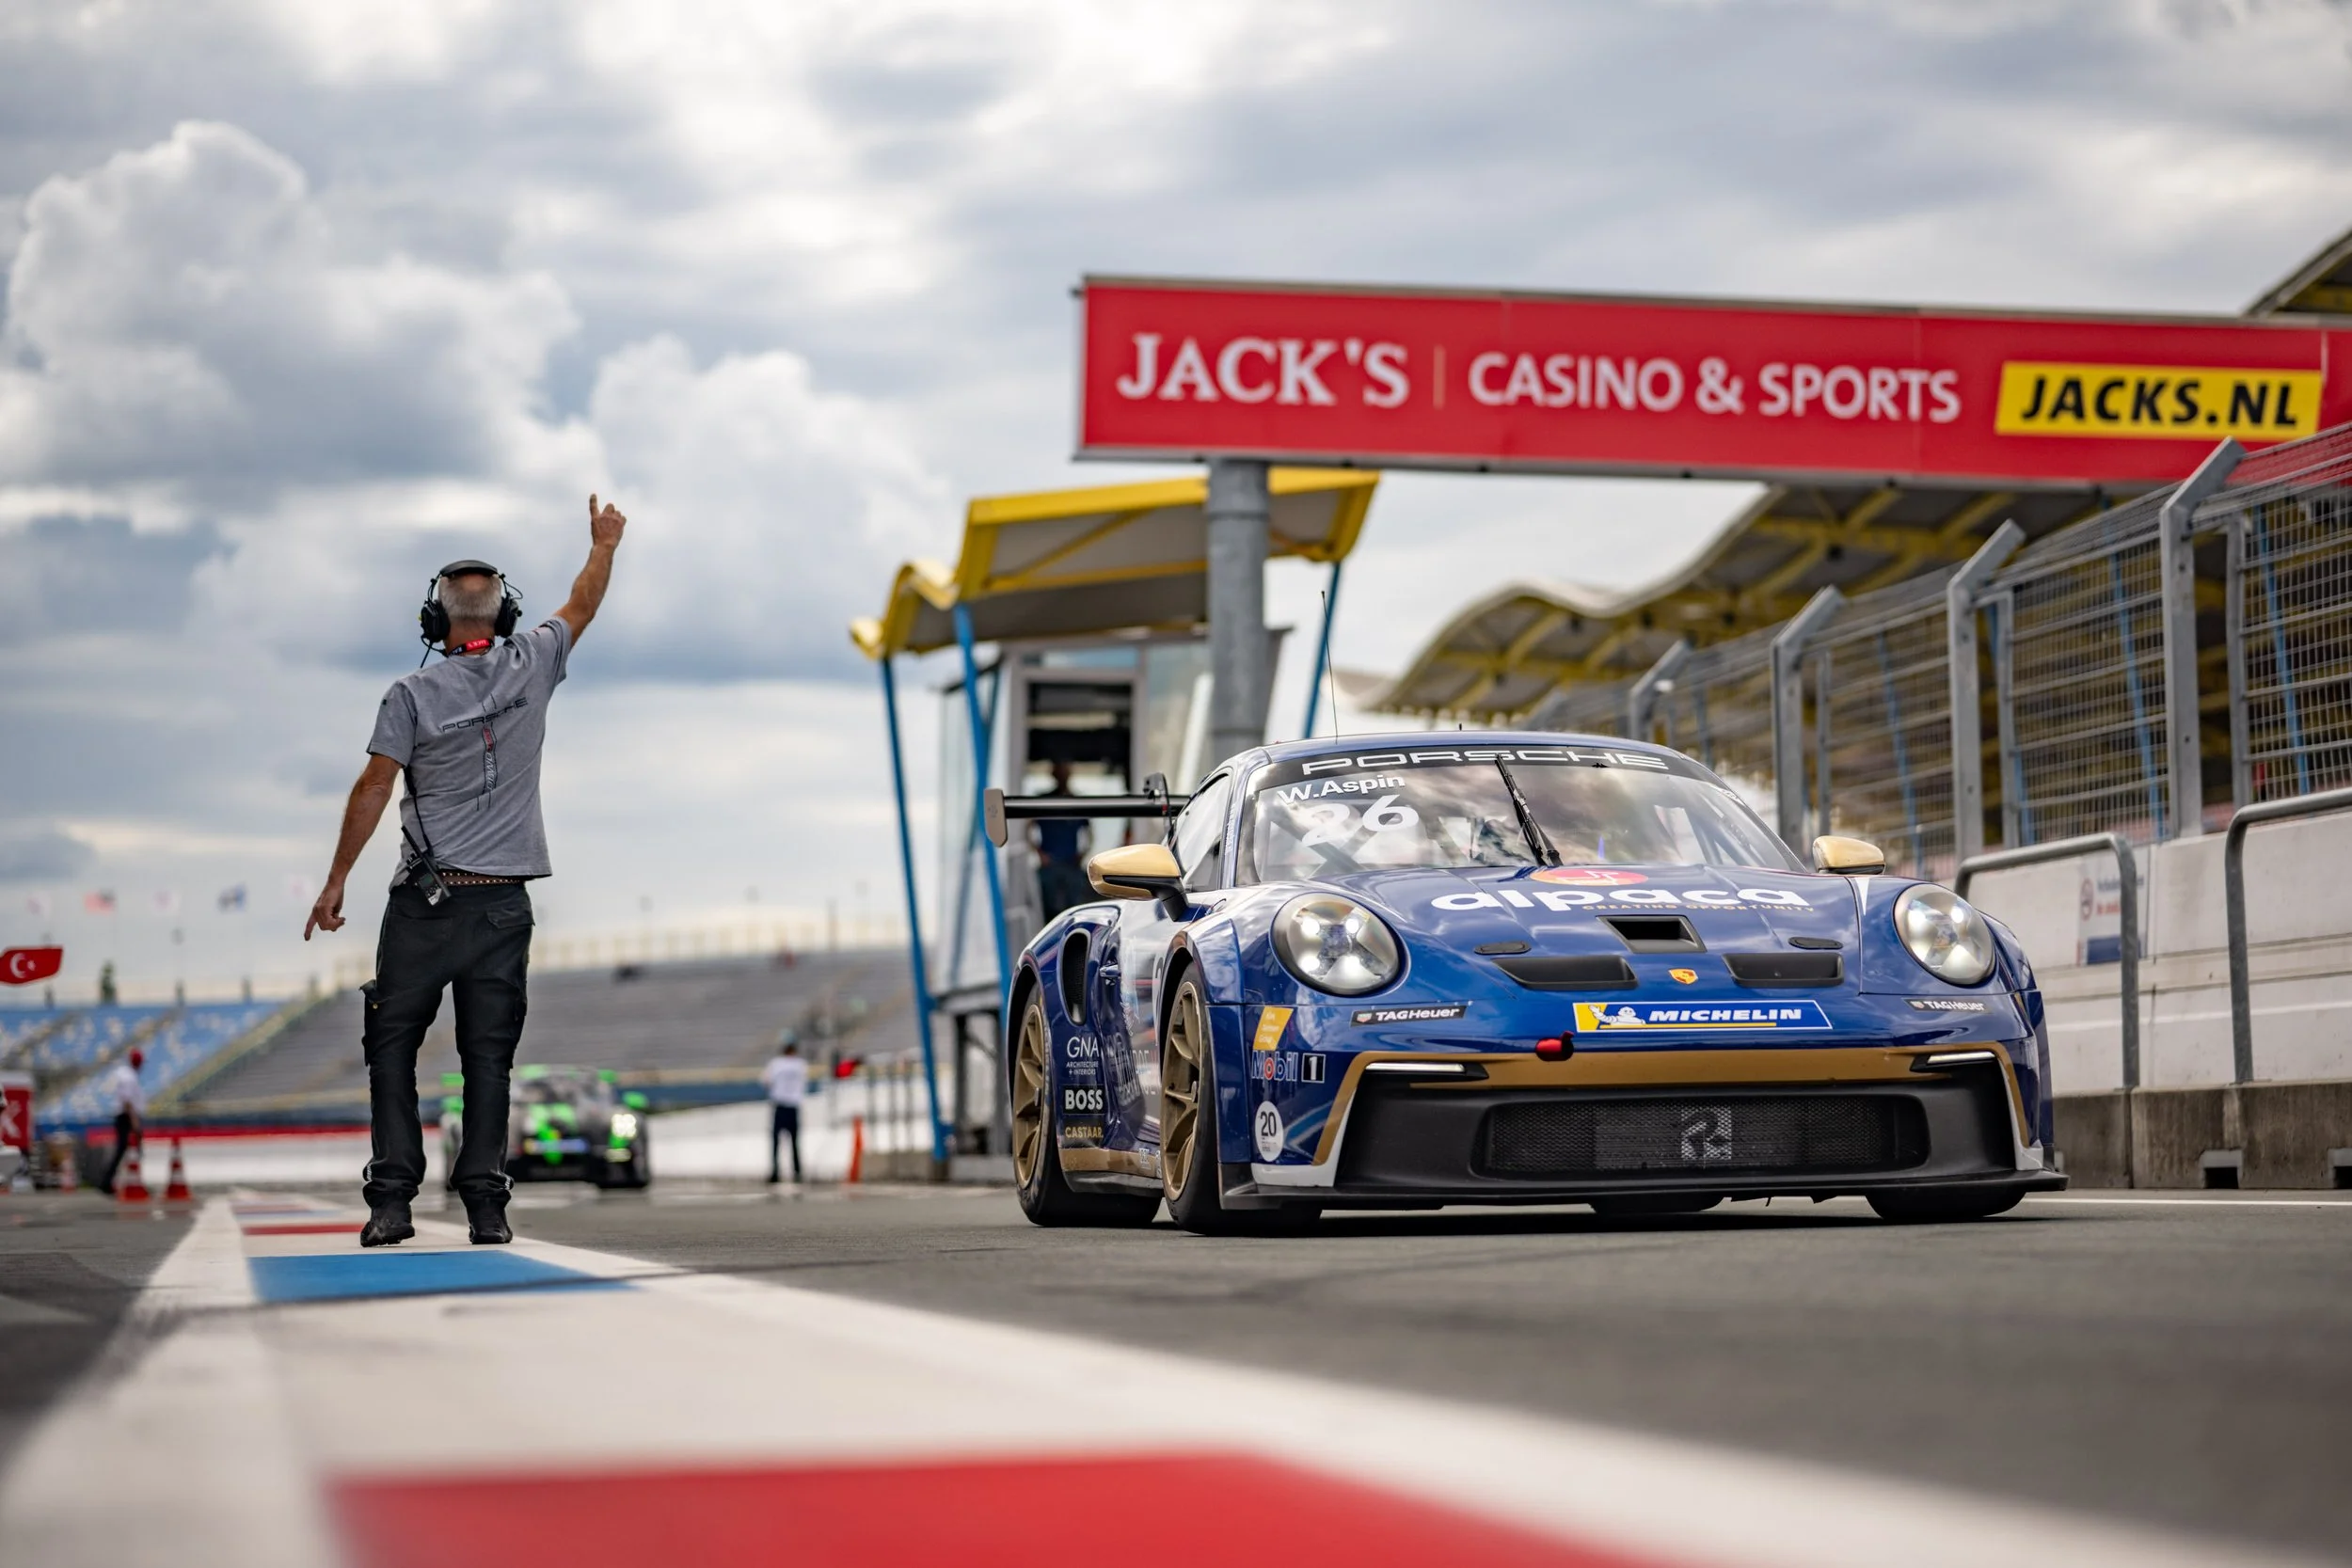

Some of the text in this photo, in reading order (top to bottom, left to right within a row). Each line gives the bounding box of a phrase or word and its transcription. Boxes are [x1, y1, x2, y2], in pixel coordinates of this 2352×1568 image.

[1116, 333, 1961, 424] JACK'S CASINO & SPORTS
[2022, 374, 2298, 426] JACKS.NL
[442, 697, 528, 733] PORSCHE
[1302, 750, 1669, 775] PORSCHE
[1277, 775, 1406, 805] W.Aspin
[1301, 794, 1421, 847] 26
[1431, 887, 1811, 911] alpaca
[1649, 1007, 1803, 1022] MICHELIN
[1067, 1036, 1100, 1058] GNA
[1251, 1051, 1298, 1082] Mobil
[1065, 1089, 1104, 1111] BOSS
[1260, 1111, 1277, 1137] 20
